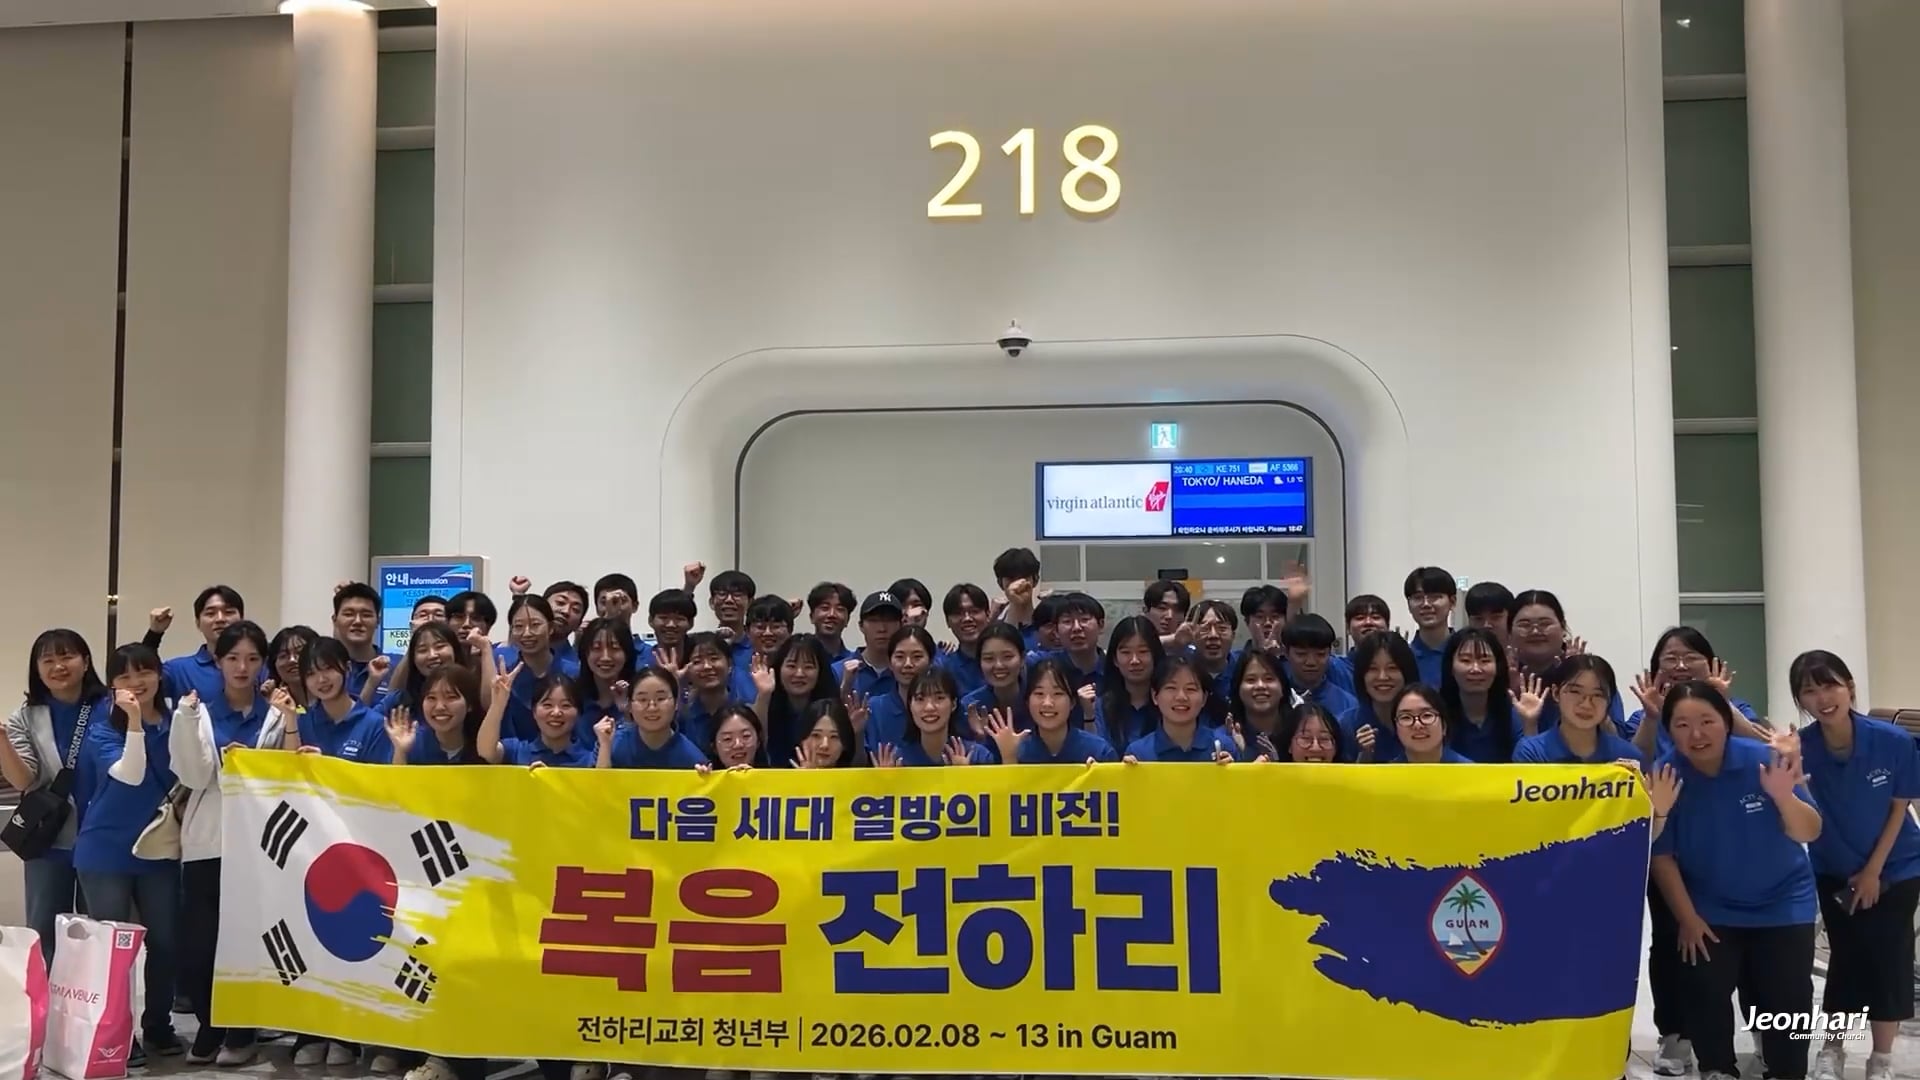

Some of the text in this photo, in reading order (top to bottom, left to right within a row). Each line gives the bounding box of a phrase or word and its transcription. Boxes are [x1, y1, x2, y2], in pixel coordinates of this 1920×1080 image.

[928, 124, 1121, 217] 218
[1182, 475, 1264, 487] TOKYO/ HANEDA
[1047, 495, 1143, 513] virgin atlantic
[385, 573, 448, 586] 안내 Information
[879, 592, 892, 602] NY
[1509, 775, 1635, 804] Jeonhari
[630, 790, 1120, 842] 다음 세대 열방의 비전!
[539, 864, 1222, 994] 복음 전하리
[1445, 919, 1489, 929] GUAM
[577, 1016, 704, 1047] 전하리교회
[713, 1018, 789, 1048] 청년부
[811, 1022, 981, 1048] 2026.02.08
[1016, 1023, 1049, 1048] 13
[1057, 1023, 1083, 1049] in
[1091, 1023, 1178, 1049] Guam
